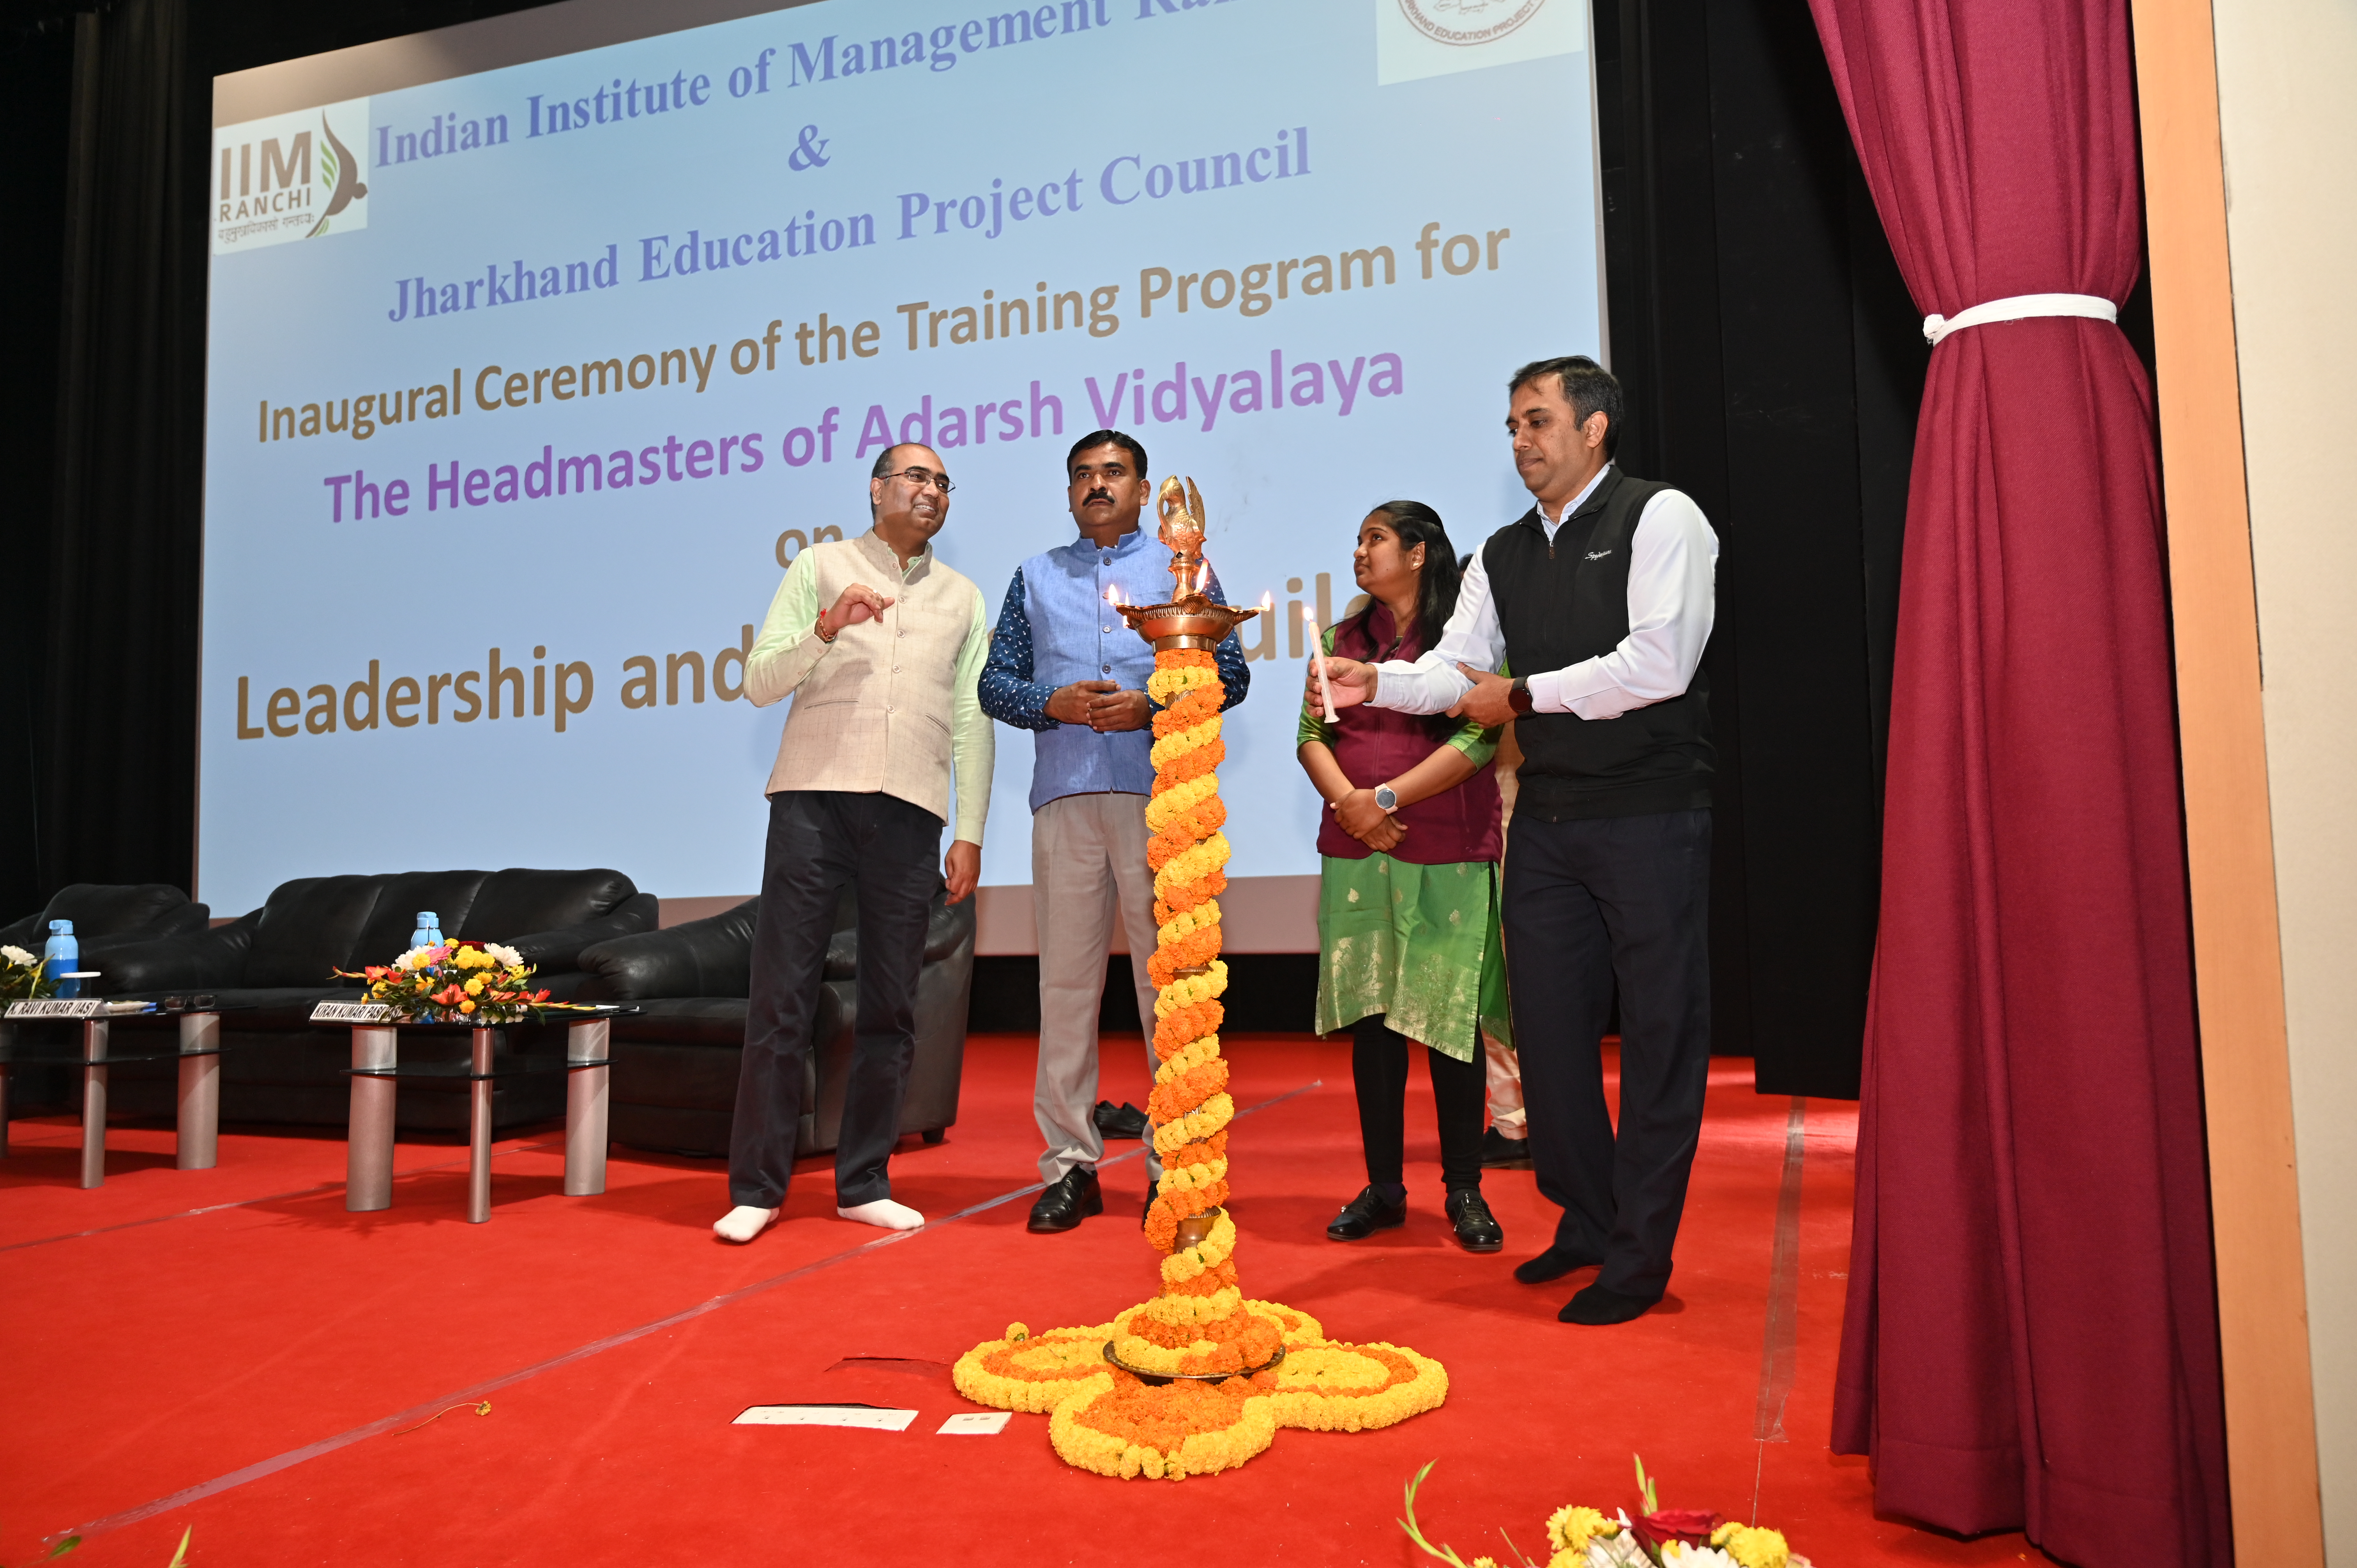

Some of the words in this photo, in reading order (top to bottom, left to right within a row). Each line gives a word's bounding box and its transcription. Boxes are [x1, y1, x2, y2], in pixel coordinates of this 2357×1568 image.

[1435, 26, 1491, 41] EDUCATION
[1493, 0, 1535, 34] PROJECT
[377, 113, 509, 167] Indian
[526, 62, 710, 138] Institute
[729, 48, 776, 97] of
[786, 0, 1111, 88] Management
[221, 131, 311, 201] IIM
[788, 125, 831, 171] &
[220, 187, 311, 222] RANCHI
[389, 244, 619, 322] Jharkhand
[638, 210, 875, 282] Education
[897, 169, 1083, 240] Project
[1100, 127, 1311, 205] Council
[260, 368, 461, 443] Inaugural
[475, 344, 717, 410] Ceremony
[730, 320, 782, 375] of
[795, 313, 880, 366] the
[896, 281, 1119, 351] Training
[1140, 246, 1395, 318] Program
[1415, 222, 1510, 279] for
[324, 470, 410, 523] The
[428, 433, 763, 511] Headmasters
[783, 406, 839, 467] of
[855, 380, 1063, 459] Adarsh
[1084, 349, 1403, 432] Vidyalaya
[237, 645, 594, 740] Leadership
[621, 624, 754, 709] and
[8, 1002, 18, 1015] K.
[19, 1002, 41, 1015] RAVI
[39, 1002, 73, 1015] KUMAR
[70, 1002, 95, 1016] (IAS)
[313, 1004, 340, 1017] KIRAN
[335, 1005, 368, 1018] KUMARI
